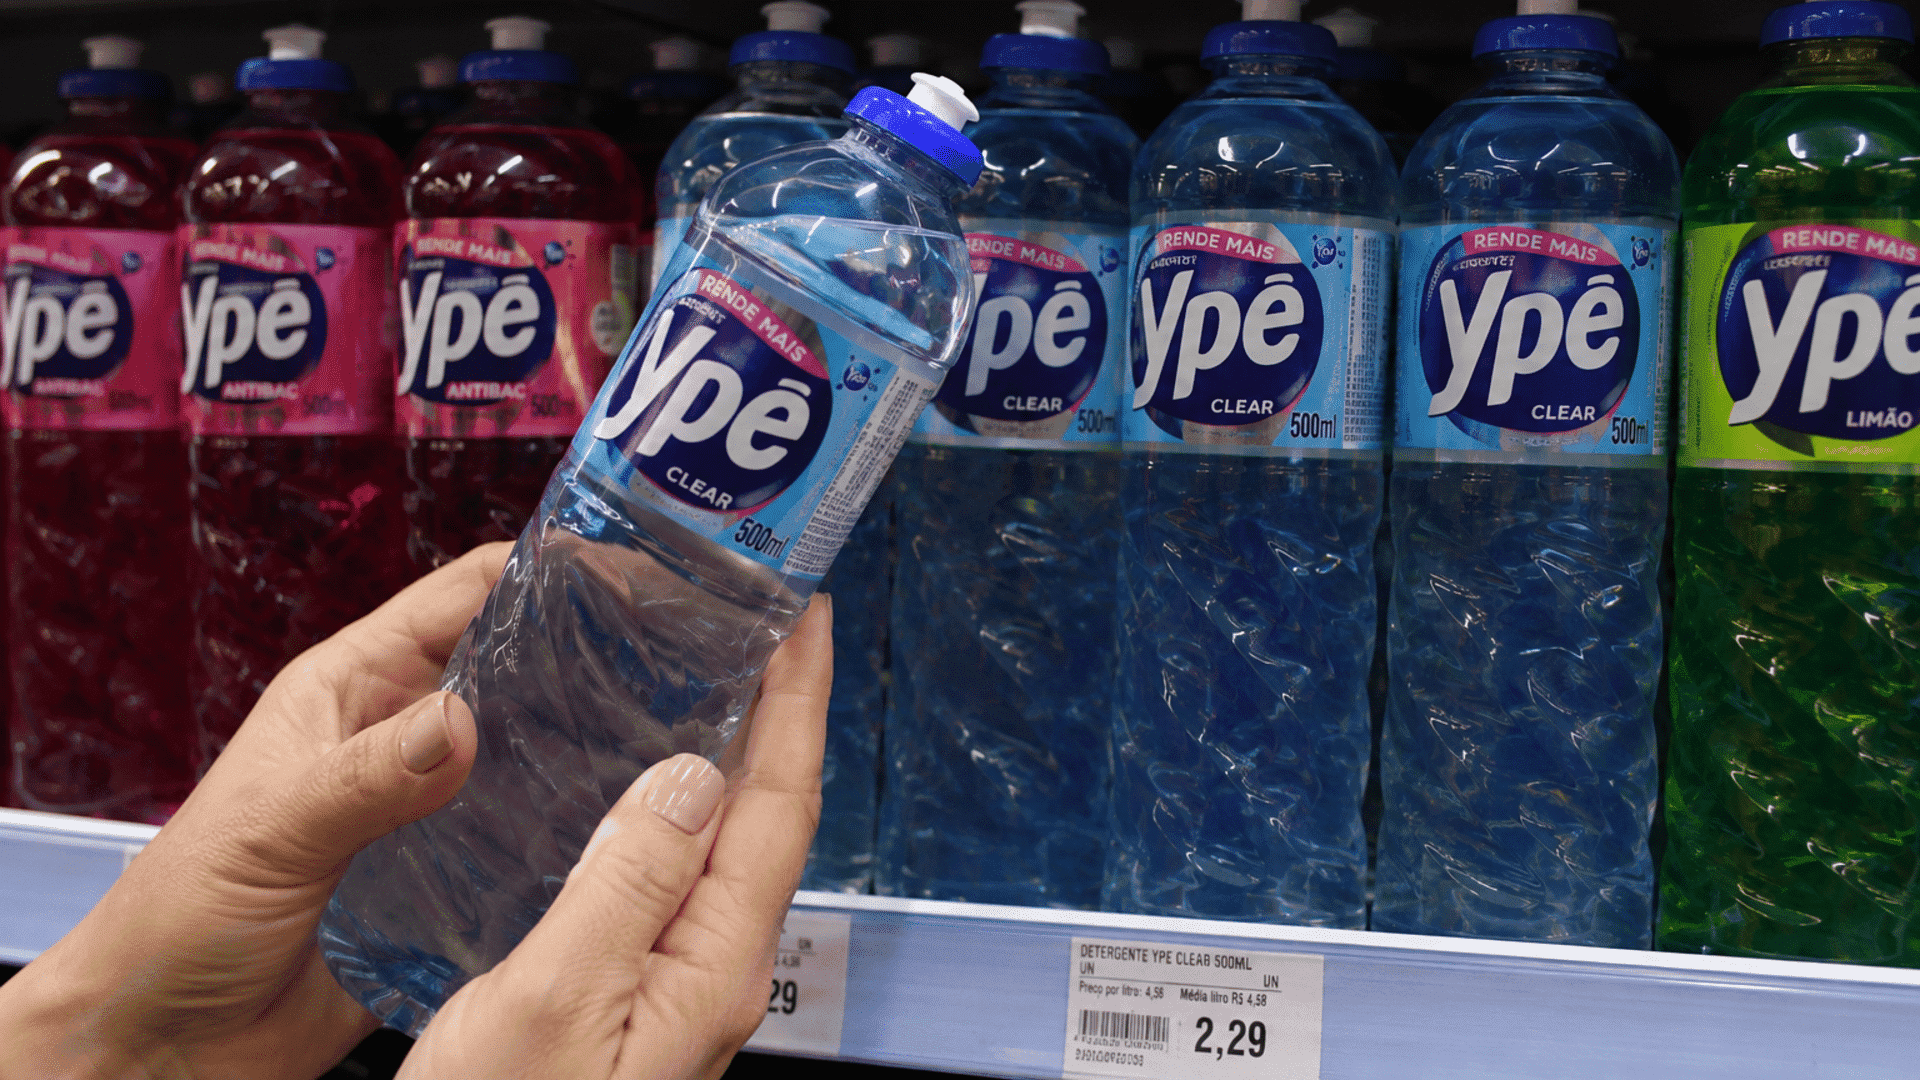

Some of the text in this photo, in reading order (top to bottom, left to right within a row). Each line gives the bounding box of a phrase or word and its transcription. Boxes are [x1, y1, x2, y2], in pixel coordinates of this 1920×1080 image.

[966, 237, 1066, 269] ENDE MAIS
[1163, 231, 1275, 260] RENDE MAIS
[1474, 231, 1598, 262] RENDE MAIS
[1782, 230, 1917, 262] RENDE MAIS
[700, 274, 760, 322] RENDE
[757, 316, 808, 362] MAIS
[965, 273, 1091, 397] pê
[1132, 269, 1305, 410] Ypê
[1428, 269, 1625, 417] Ypê
[446, 382, 526, 400] ANTIBAC
[593, 307, 812, 472] Ypê
[1003, 395, 1063, 412] CLEAR
[1211, 399, 1274, 415] CLEAR
[1531, 404, 1596, 421] CLEAR
[1846, 407, 1913, 428] LIMÃO
[1290, 412, 1337, 439] 500ml
[1611, 416, 1649, 445] 500ml
[665, 466, 734, 510] CLEAR
[734, 517, 791, 559] 500ml
[1080, 943, 1149, 963] DETERGENTE
[1152, 949, 1172, 965] YPE
[1214, 954, 1252, 971] 500ML
[1080, 961, 1095, 975] UN
[1106, 985, 1119, 997] por
[1263, 974, 1279, 988] UN
[1180, 987, 1208, 1003] Média
[1246, 993, 1267, 1007] 4,58
[1194, 1016, 1267, 1062] 2,29
